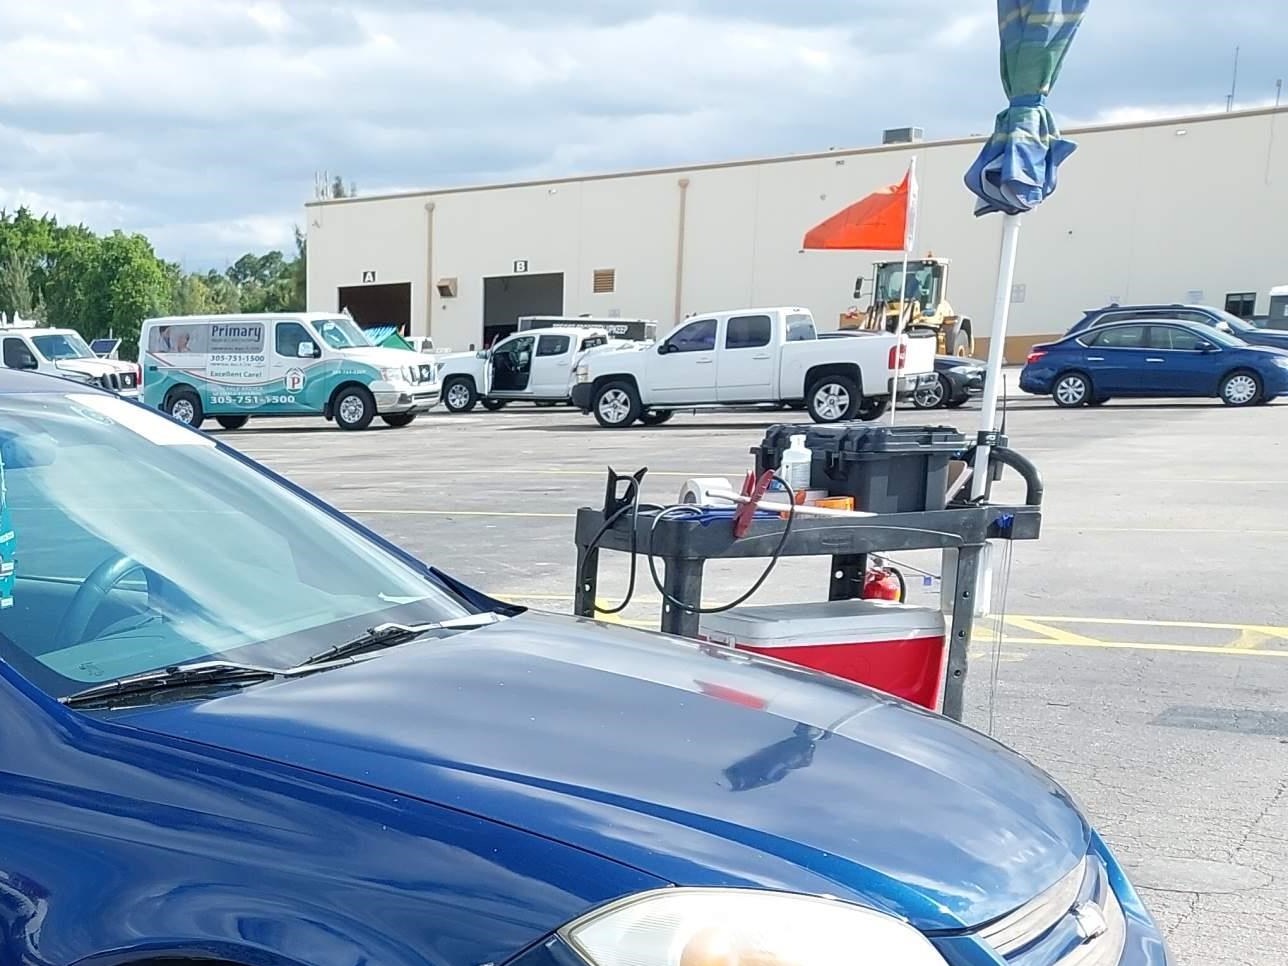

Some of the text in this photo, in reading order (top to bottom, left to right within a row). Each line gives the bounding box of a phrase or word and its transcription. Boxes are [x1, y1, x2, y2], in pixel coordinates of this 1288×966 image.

[516, 261, 526, 272] B
[365, 271, 375, 282] A
[211, 325, 262, 343] Primary
[210, 354, 265, 363] 305-751-1500
[210, 370, 263, 380] Excellent Care!
[210, 395, 296, 405] 305-751-1500
